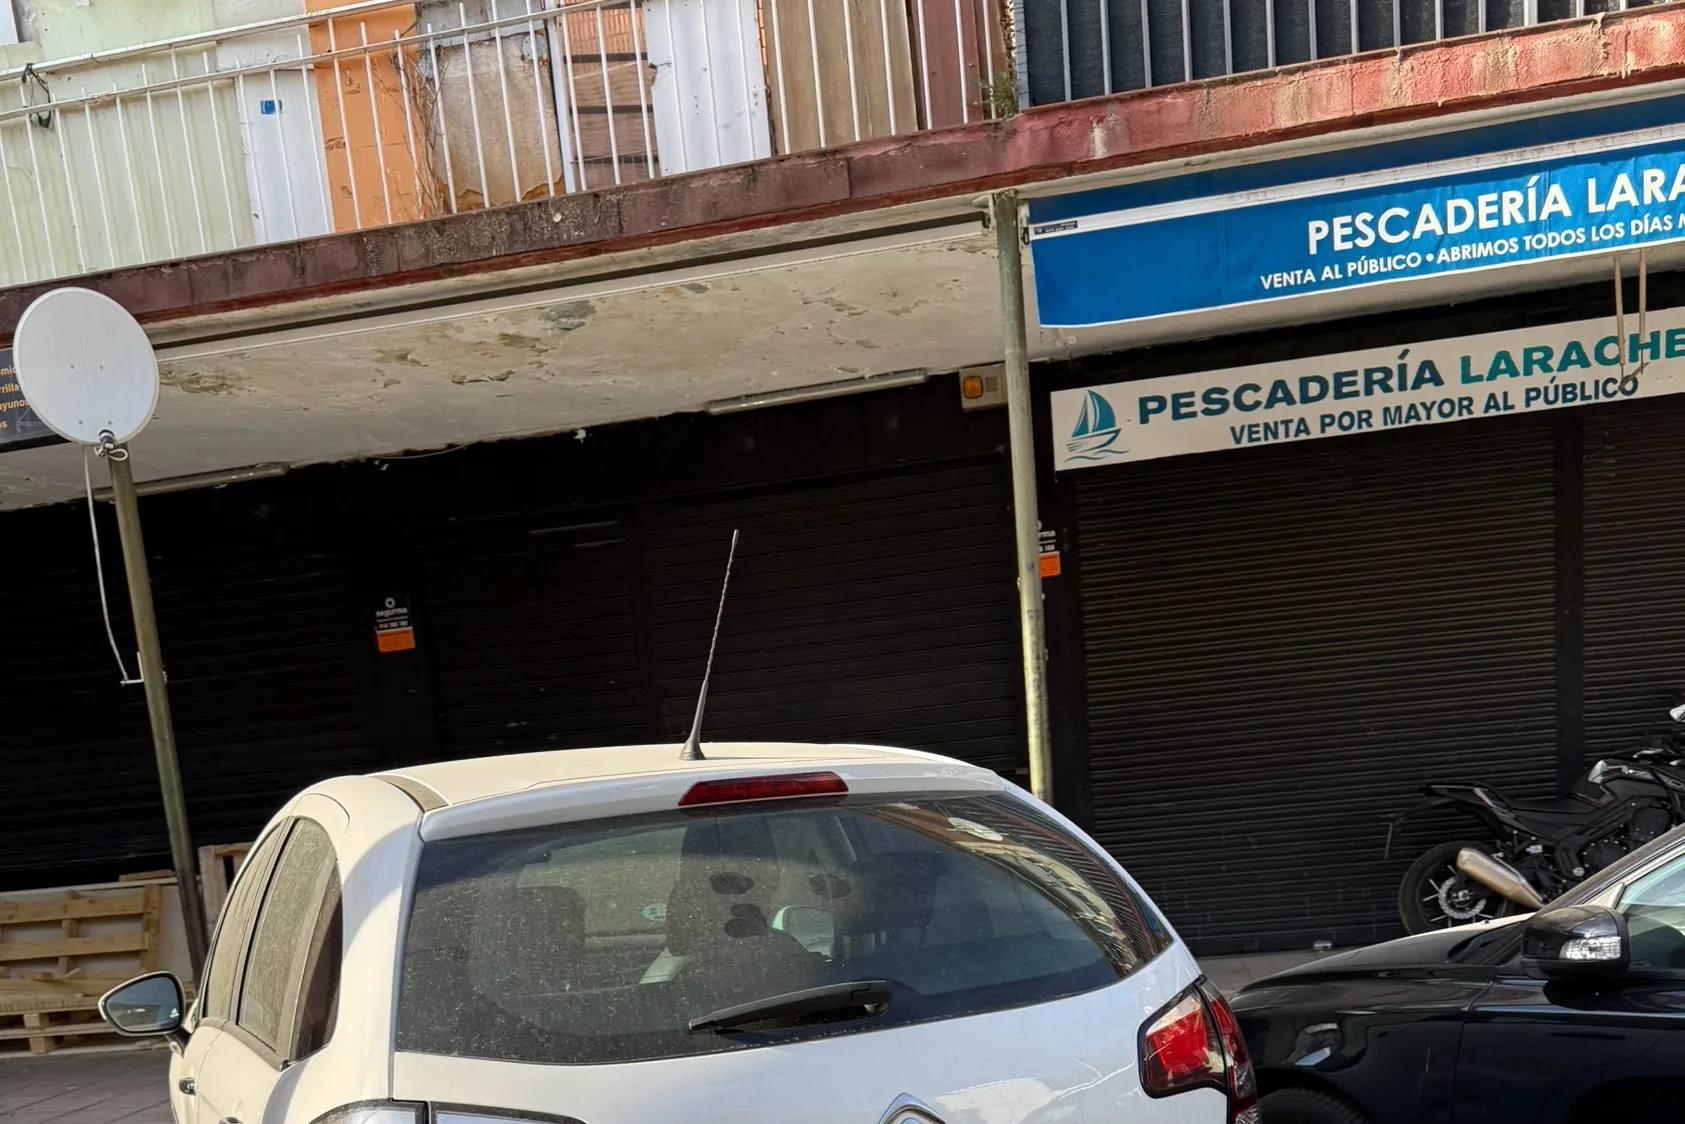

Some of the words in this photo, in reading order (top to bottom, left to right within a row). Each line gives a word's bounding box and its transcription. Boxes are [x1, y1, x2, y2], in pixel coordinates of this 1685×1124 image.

[1260, 269, 1316, 289] VENTA
[1321, 264, 1343, 281] AL
[1347, 252, 1422, 277] PÚBLICO
[1437, 238, 1519, 264] ABRIMOS
[1524, 227, 1586, 250] TODOS
[1591, 222, 1625, 242] LOS
[1630, 213, 1673, 236] DÍAS
[1308, 176, 1572, 255] PESCADERÍA
[1138, 349, 1445, 424] PESCADERÍA
[1460, 328, 1685, 385] LARACHE
[1230, 417, 1311, 445] VENTA
[1320, 409, 1373, 434] POR
[1383, 396, 1474, 426] MAYOR
[1483, 391, 1515, 413] AL
[1525, 375, 1639, 408] PÚBLICO
